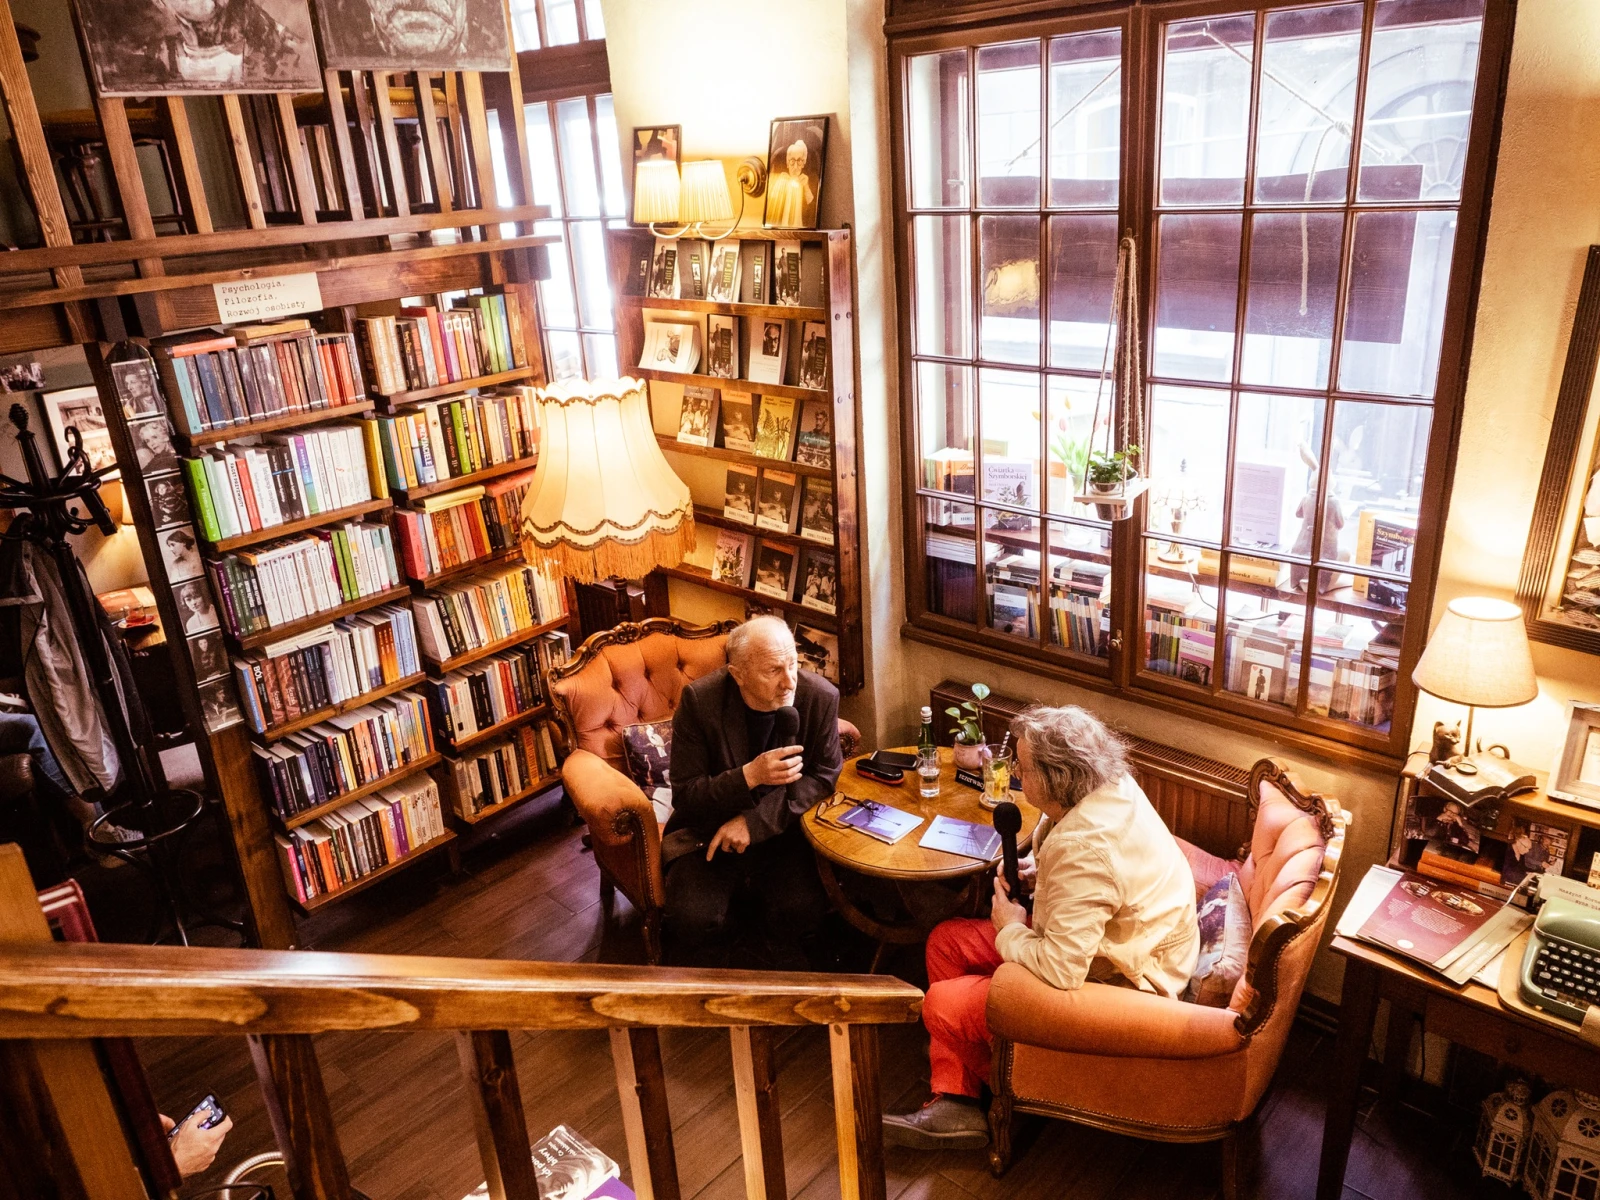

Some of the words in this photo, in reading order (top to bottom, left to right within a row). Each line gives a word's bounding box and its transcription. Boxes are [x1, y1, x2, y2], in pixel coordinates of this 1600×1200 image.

[222, 281, 286, 294] Psychologia,
[225, 293, 278, 305] Filozofia,
[227, 307, 260, 317] Rozwój
[265, 301, 306, 312] osobisty
[501, 418, 509, 437] GENY
[417, 423, 433, 466] PRZYJACIELE
[988, 465, 1014, 473] Ćwiartka
[252, 665, 263, 681] BÓL
[386, 811, 395, 829] OSHO
[538, 1147, 559, 1167] bitwy
